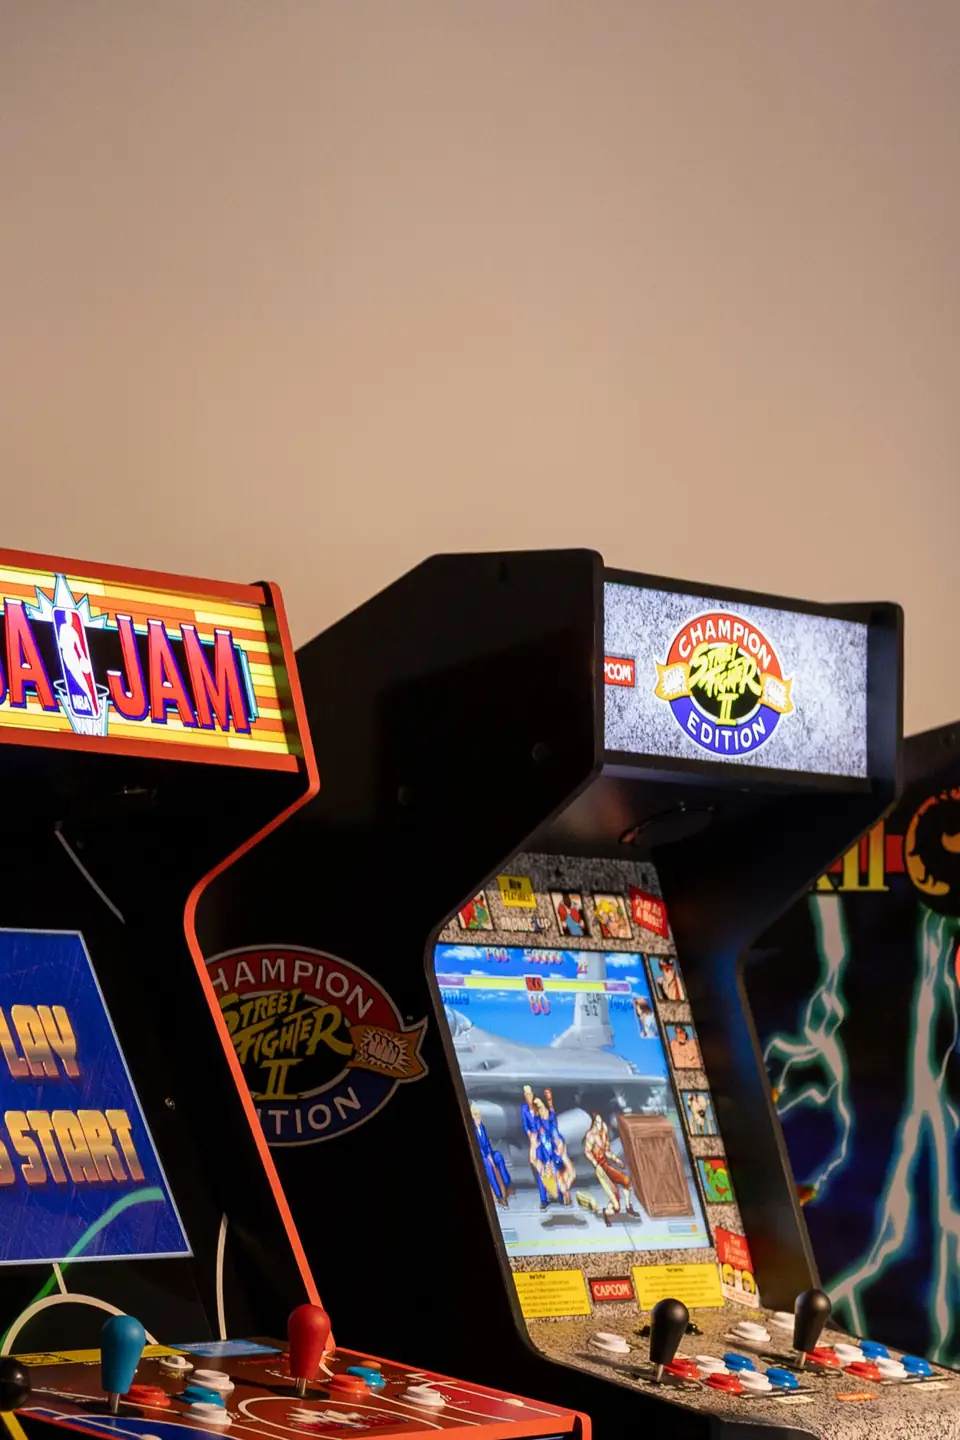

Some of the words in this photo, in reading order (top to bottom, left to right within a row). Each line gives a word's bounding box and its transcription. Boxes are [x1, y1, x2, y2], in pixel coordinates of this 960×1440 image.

[678, 619, 772, 671] CHAMPION
[107, 614, 251, 734] JAM
[71, 693, 92, 711] NBA
[715, 692, 740, 726] II
[687, 710, 766, 751] EDITION
[253, 1058, 304, 1101] II
[4, 1109, 145, 1185] START
[593, 1282, 631, 1297] CAPCOM
